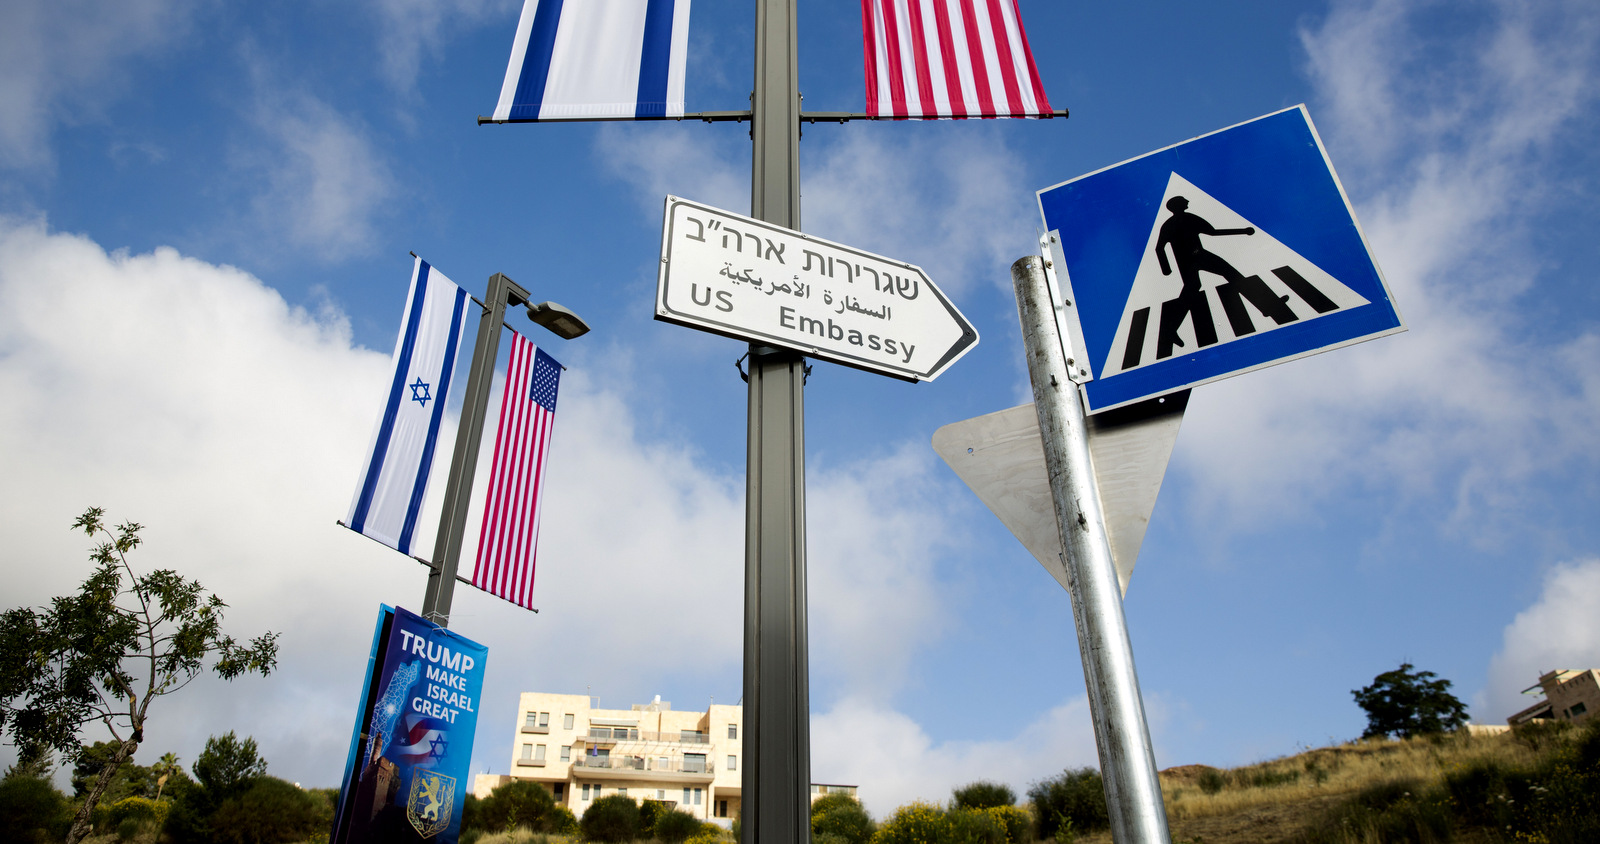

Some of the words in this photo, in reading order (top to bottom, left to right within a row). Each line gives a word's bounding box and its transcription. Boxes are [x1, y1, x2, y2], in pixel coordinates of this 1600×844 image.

[718, 261, 811, 300] الأمريكية
[801, 249, 919, 301] שגרירות
[823, 289, 892, 321] السفارة
[691, 282, 734, 313] US
[779, 305, 916, 364] Embassy
[400, 629, 475, 675] TRUMP
[425, 664, 467, 692] MAKE
[412, 696, 459, 724] GREAT
[426, 683, 474, 713] ISRAEL
